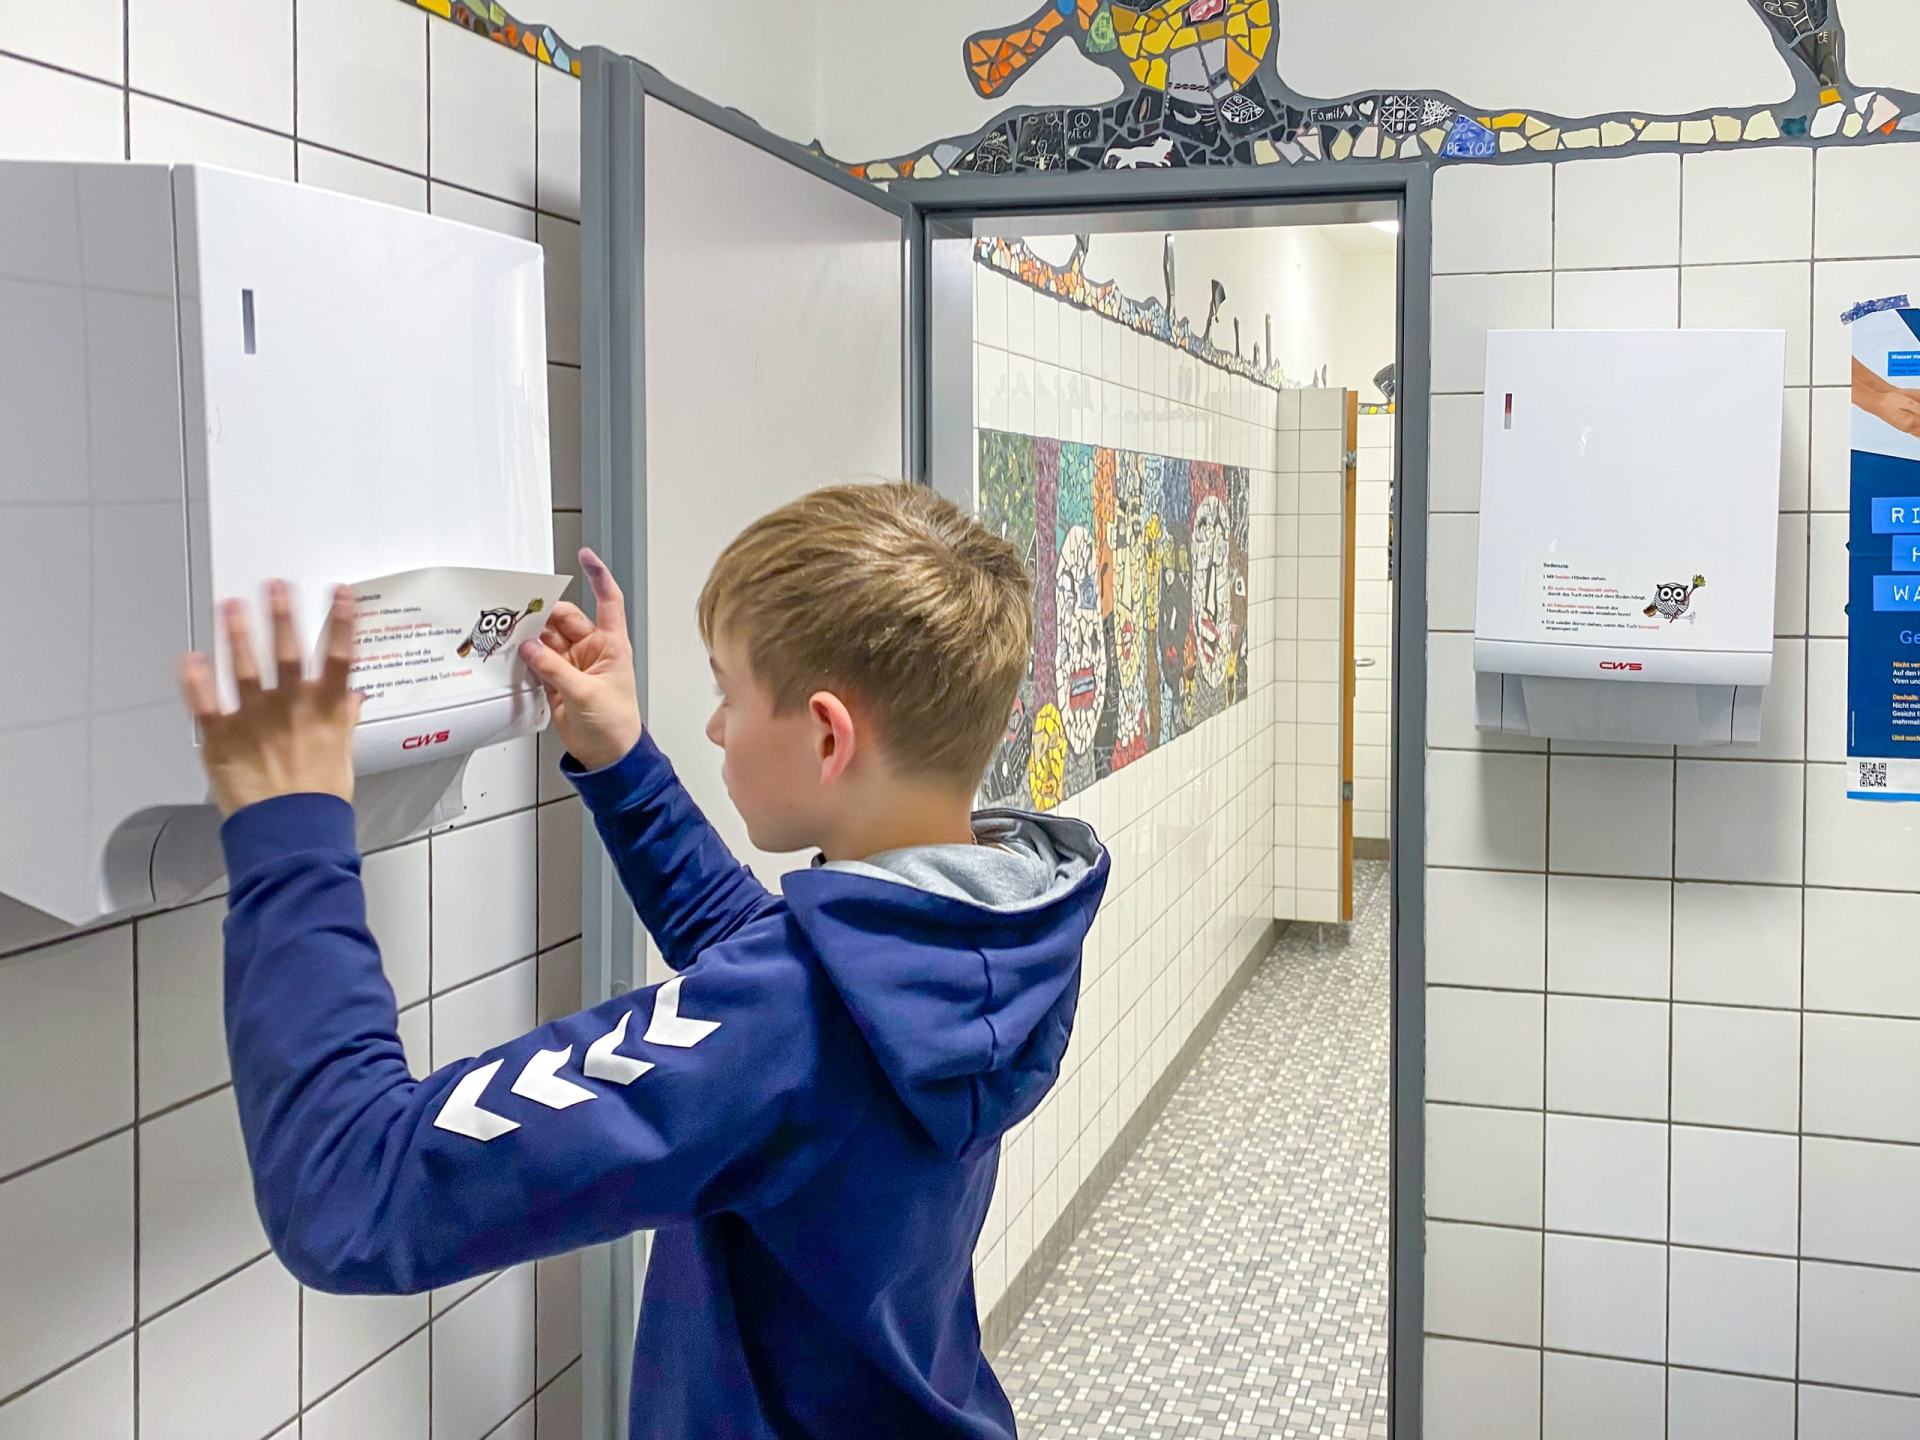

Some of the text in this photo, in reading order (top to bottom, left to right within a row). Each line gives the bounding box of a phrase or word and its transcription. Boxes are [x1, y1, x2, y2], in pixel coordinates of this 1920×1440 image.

[1310, 107, 1345, 122] Family
[1447, 141, 1495, 155] BE YOU
[1599, 661, 1642, 671] CWS
[402, 729, 450, 750] CWS
